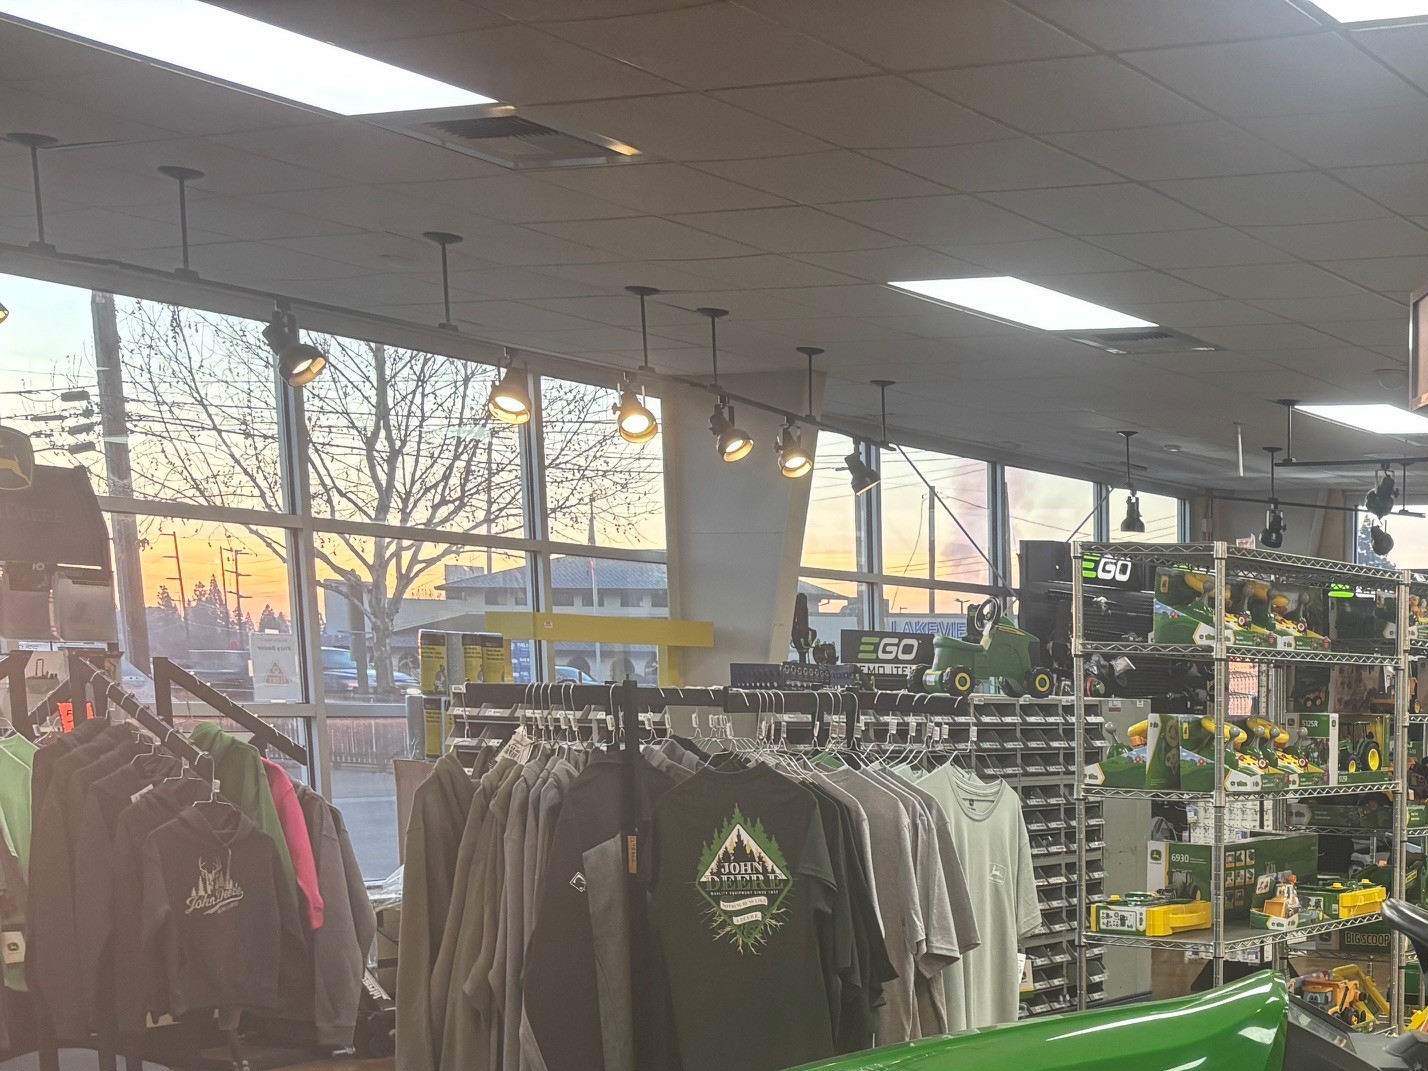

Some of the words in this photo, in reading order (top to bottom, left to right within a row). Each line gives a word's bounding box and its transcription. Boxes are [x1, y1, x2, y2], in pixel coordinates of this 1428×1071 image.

[1082, 553, 1132, 582] EGO
[890, 620, 967, 639] LAKEVIE
[858, 636, 919, 661] EGO
[1172, 854, 1190, 862] 6930
[721, 861, 763, 874] JOHN
[705, 873, 784, 891] DEERE
